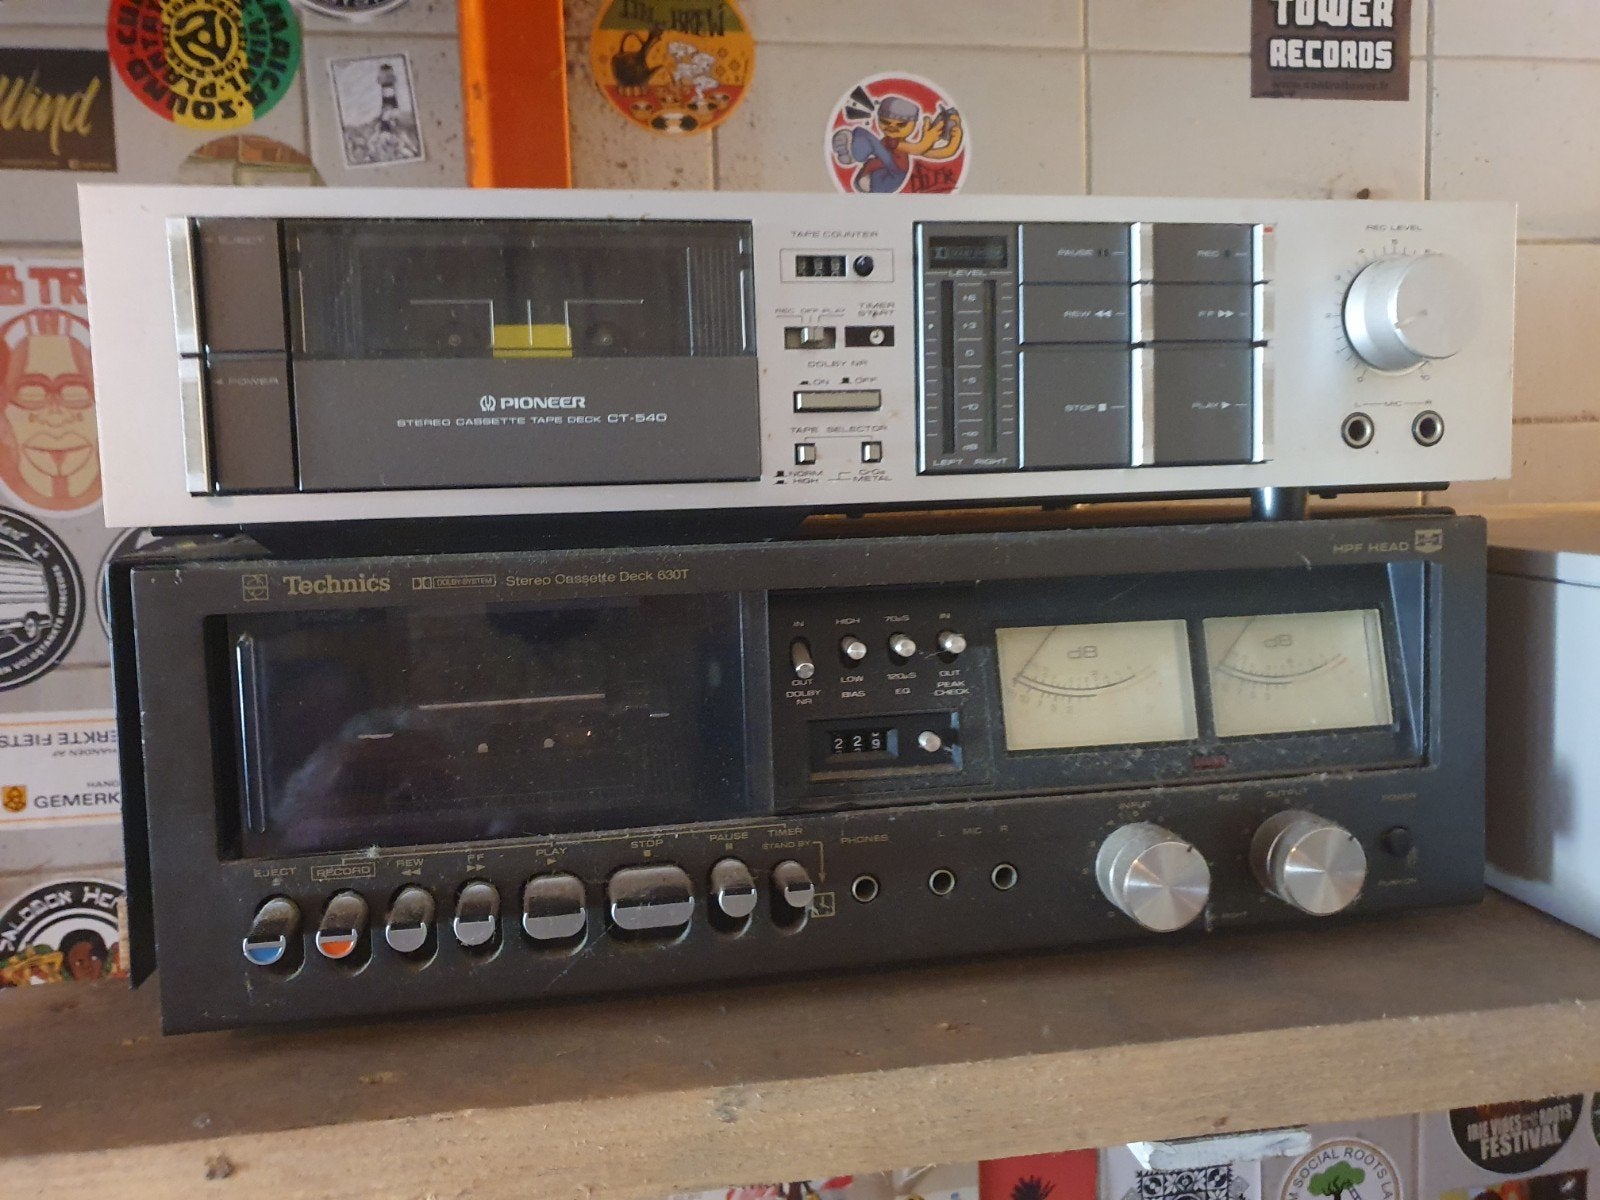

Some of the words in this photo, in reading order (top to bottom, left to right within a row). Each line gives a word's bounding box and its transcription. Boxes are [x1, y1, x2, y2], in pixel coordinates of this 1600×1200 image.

[1270, 39, 1393, 69] RECORDS
[500, 396, 586, 409] PIONEER
[1064, 404, 1095, 412] STOP
[397, 418, 451, 427] STEREO
[456, 417, 526, 426] CASSETTE
[531, 416, 562, 424] TAPE
[568, 415, 600, 424] DECK
[607, 413, 668, 423] CT-540
[1333, 543, 1363, 554] HPF
[1368, 541, 1410, 552] HEAD
[506, 575, 552, 587] Stereo
[555, 572, 616, 586] Cassette
[619, 570, 653, 582] Deck
[657, 569, 690, 580] 630T
[283, 573, 391, 595] Technics
[938, 669, 961, 677] OUT
[840, 675, 864, 683] LOW
[785, 689, 822, 698] DOLBY
[841, 690, 866, 699] BIAS
[709, 832, 749, 842] PAUSE
[767, 828, 803, 837] TIMER
[630, 839, 664, 849] STOP
[840, 834, 889, 845] PHONES
[467, 853, 485, 861] FF
[535, 847, 567, 856] PLAY
[396, 859, 424, 868] REW
[253, 867, 297, 878] EJECT
[316, 866, 371, 877] RECORD
[82, 885, 118, 909] HE
[1480, 1122, 1562, 1160] FESTIVAL
[1292, 1149, 1340, 1188] SOCIAL
[1343, 1146, 1388, 1179] ROOTS
